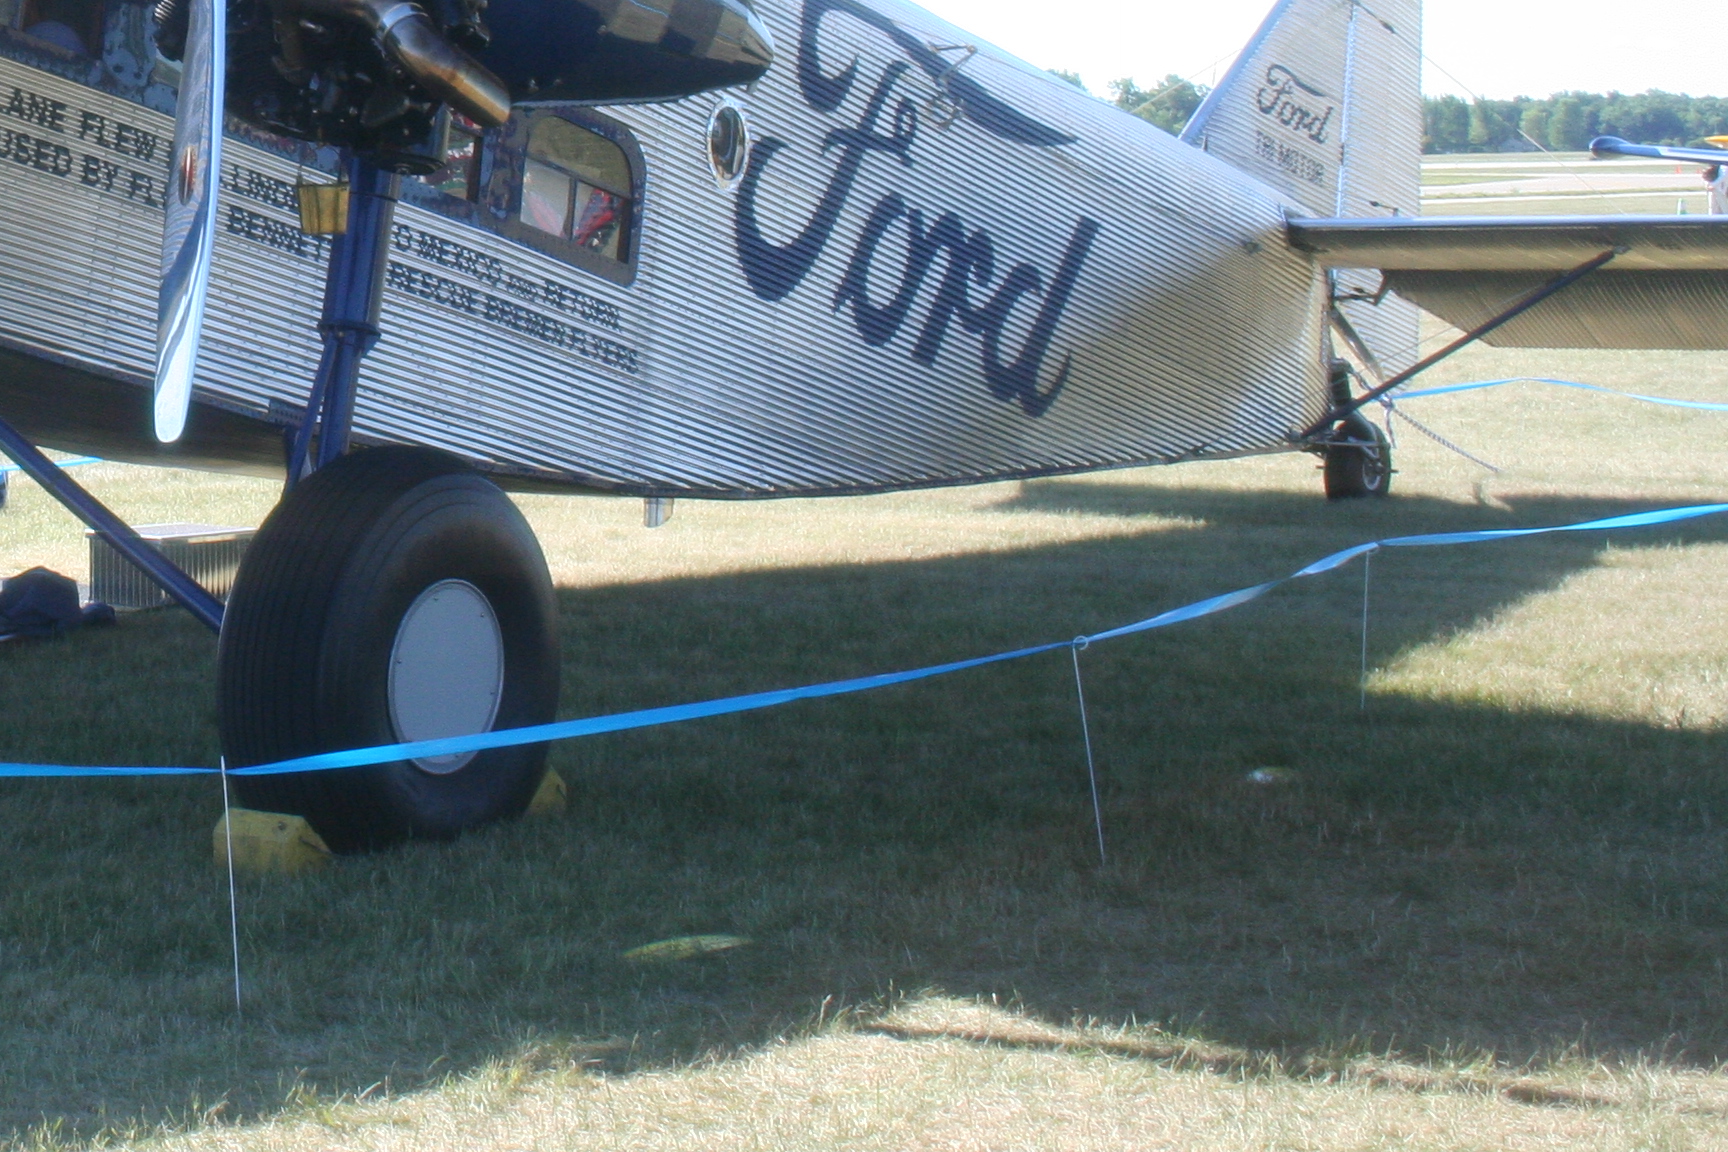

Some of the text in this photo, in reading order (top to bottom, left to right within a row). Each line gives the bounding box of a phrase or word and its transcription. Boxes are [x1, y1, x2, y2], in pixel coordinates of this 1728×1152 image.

[1256, 63, 1334, 145] Ford
[78, 108, 158, 162] FLEW
[419, 231, 502, 288] MEXICO
[543, 280, 622, 334] RETURN
[81, 153, 119, 192] BY
[226, 203, 334, 264] BENNET
[384, 261, 476, 315] RESCUE
[481, 291, 564, 347] BREMEN
[566, 323, 640, 375] FLYERS
